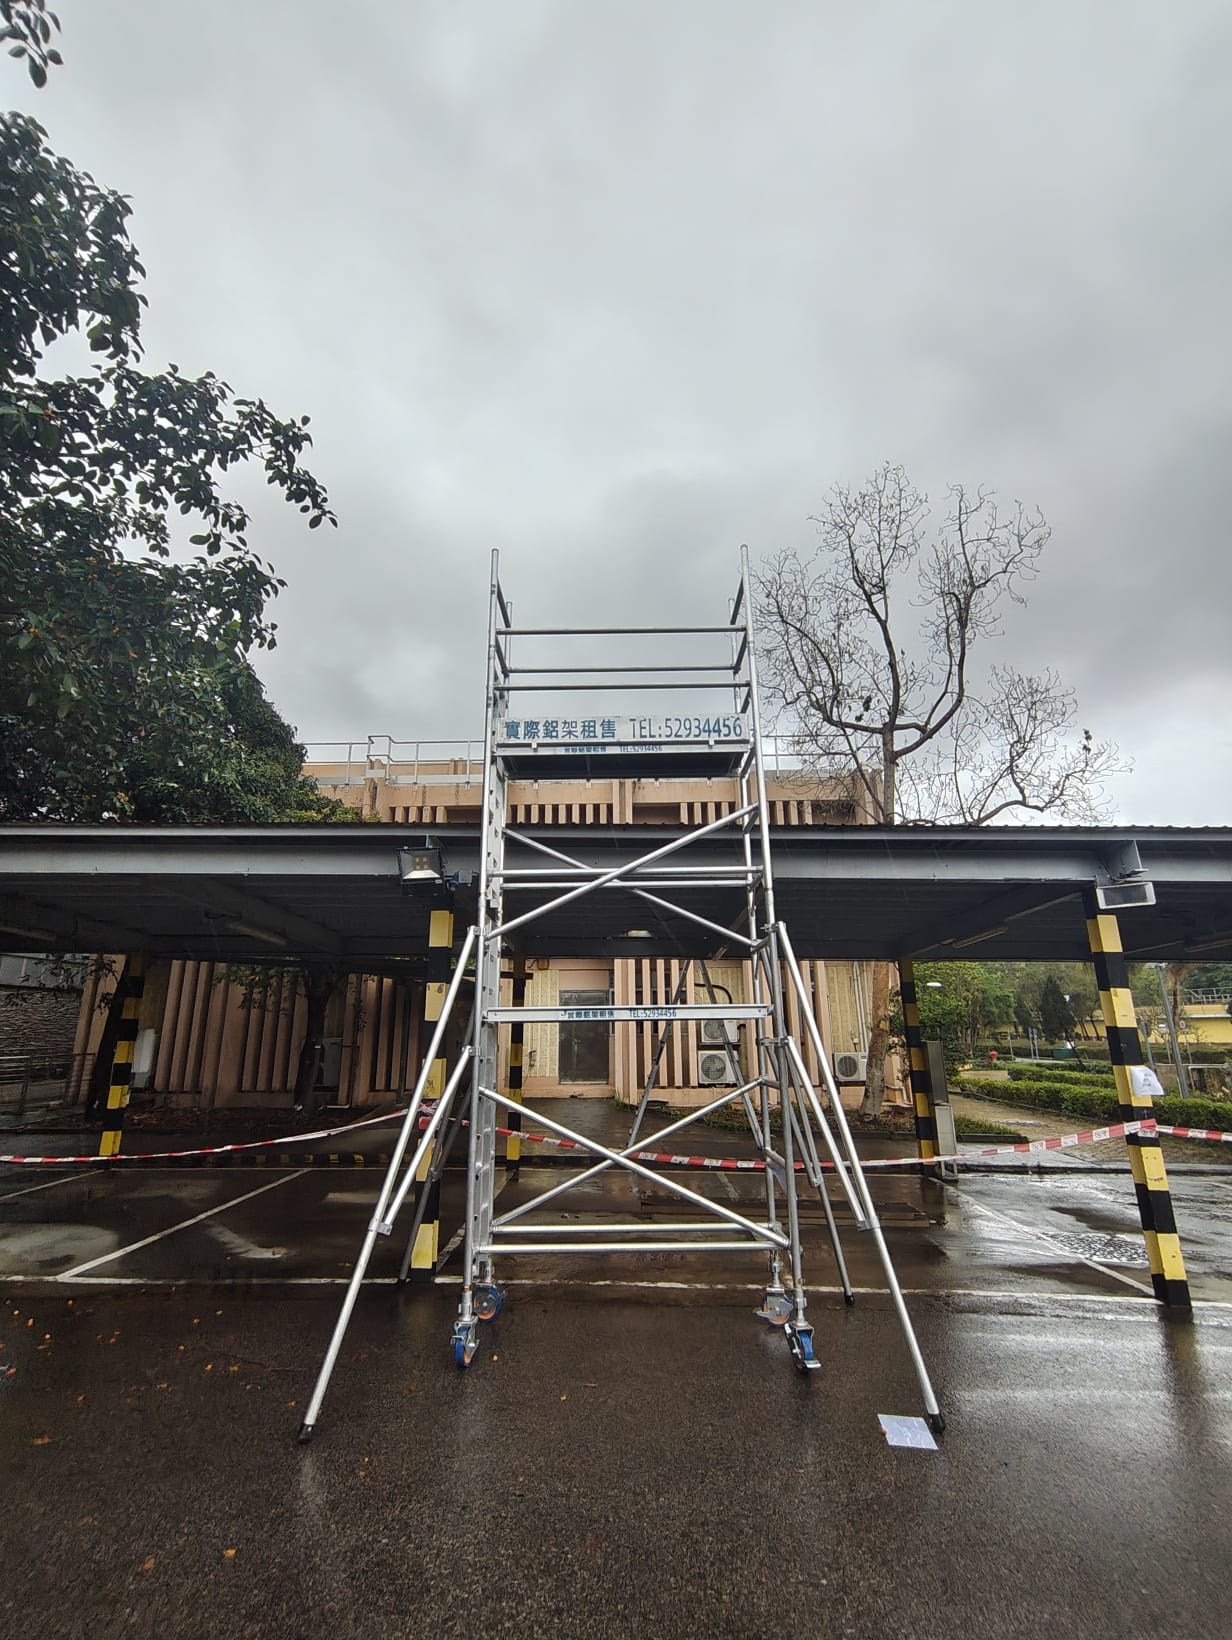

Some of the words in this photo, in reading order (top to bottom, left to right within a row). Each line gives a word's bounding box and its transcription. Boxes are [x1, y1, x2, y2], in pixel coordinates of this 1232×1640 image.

[505, 720, 616, 739] 實際鋁架租售
[629, 718, 743, 739] TEL:52934456
